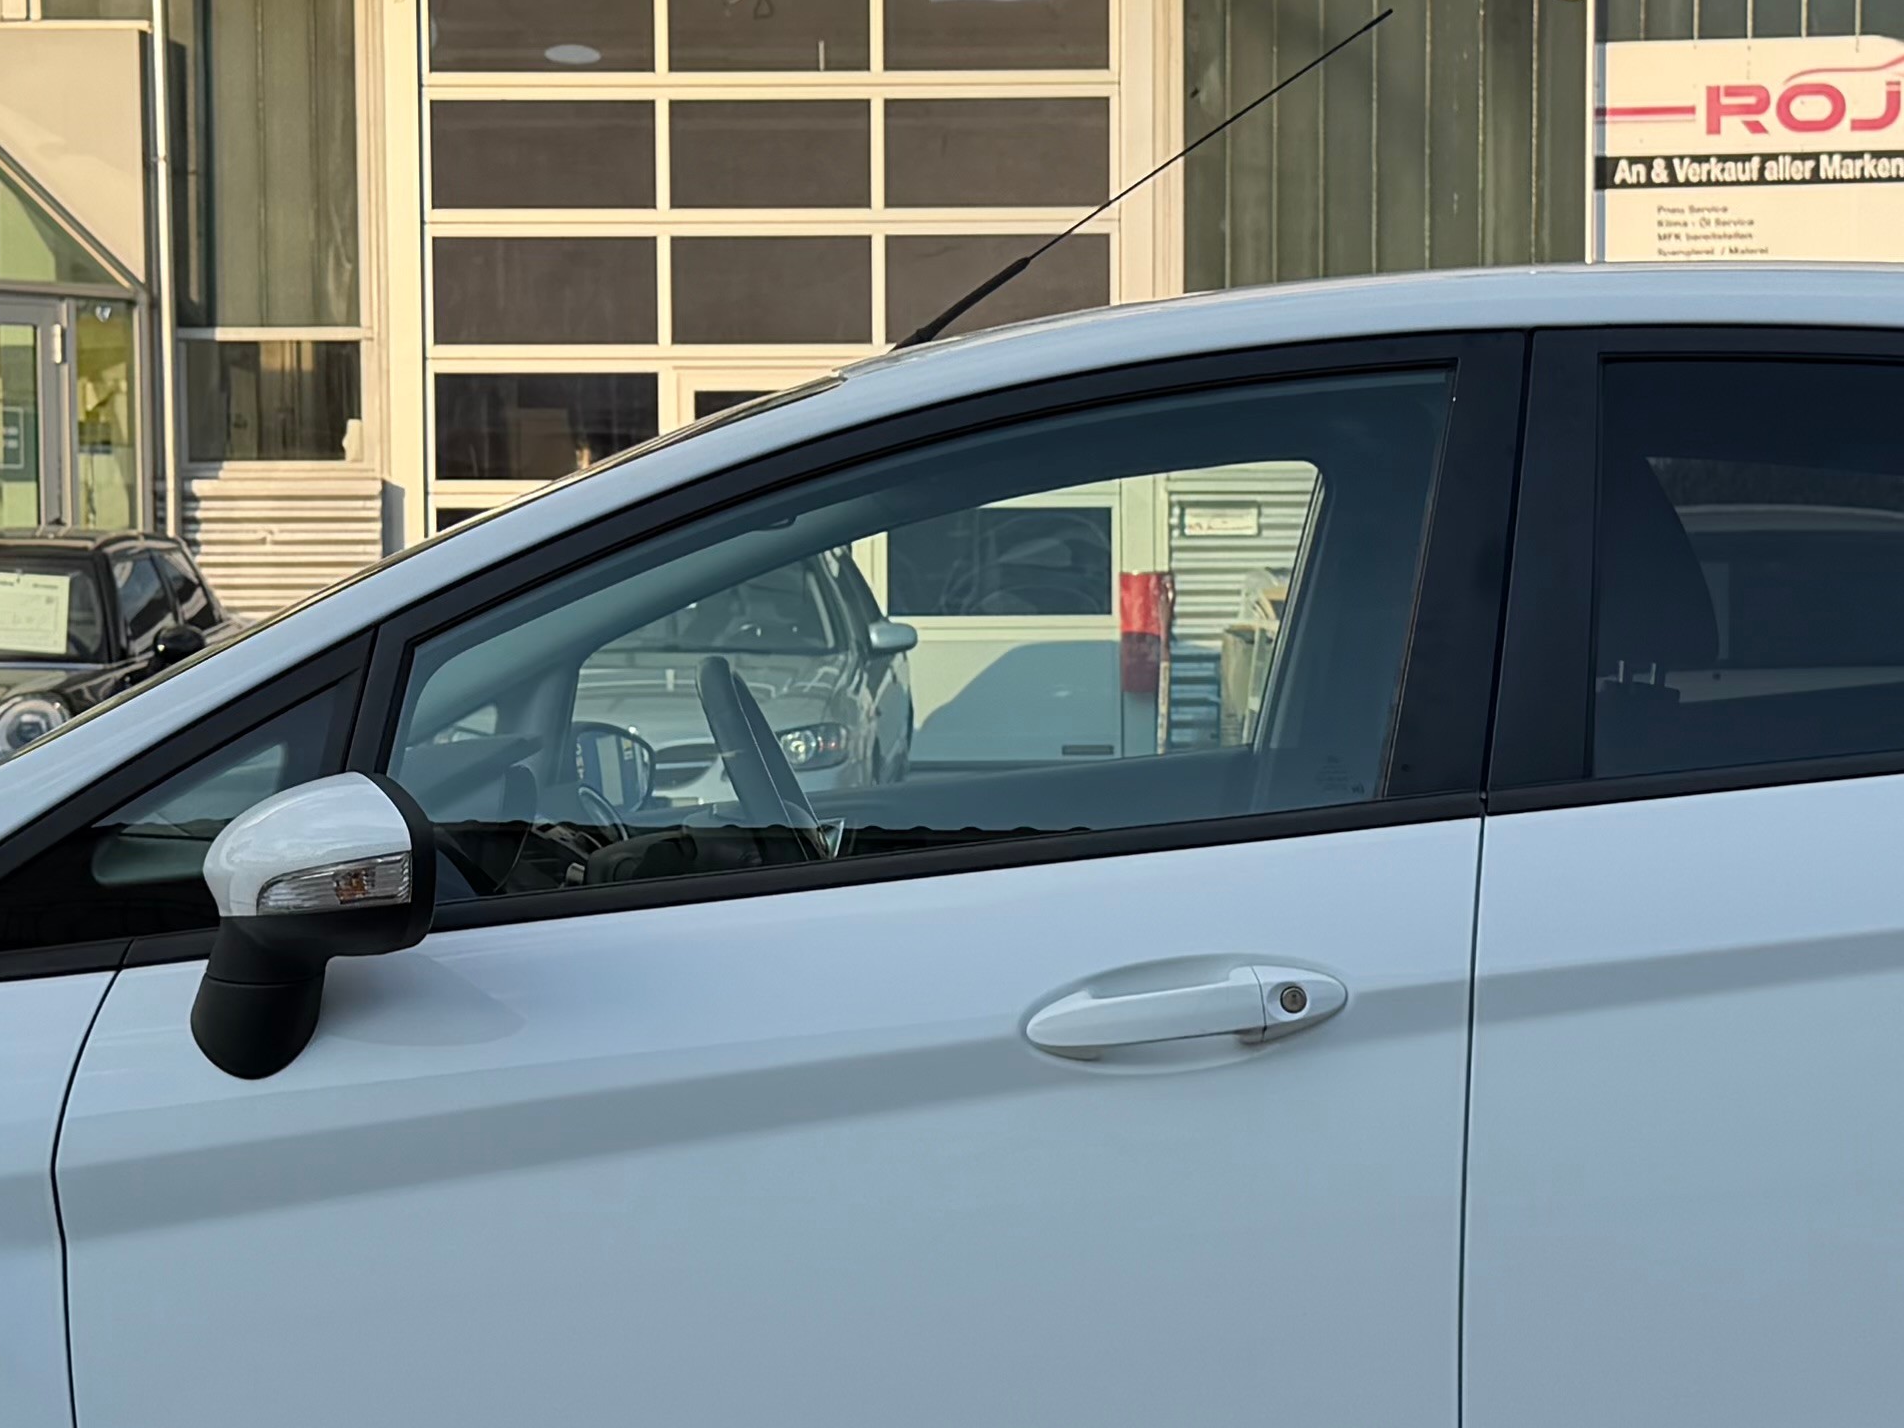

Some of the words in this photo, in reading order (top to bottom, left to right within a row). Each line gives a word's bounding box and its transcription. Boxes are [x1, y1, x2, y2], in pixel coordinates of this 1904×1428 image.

[1706, 80, 1901, 136] ROJ
[1613, 158, 1646, 185] An
[1650, 157, 1669, 183] &
[1672, 155, 1762, 183] Verkauf
[1764, 153, 1815, 181] aller
